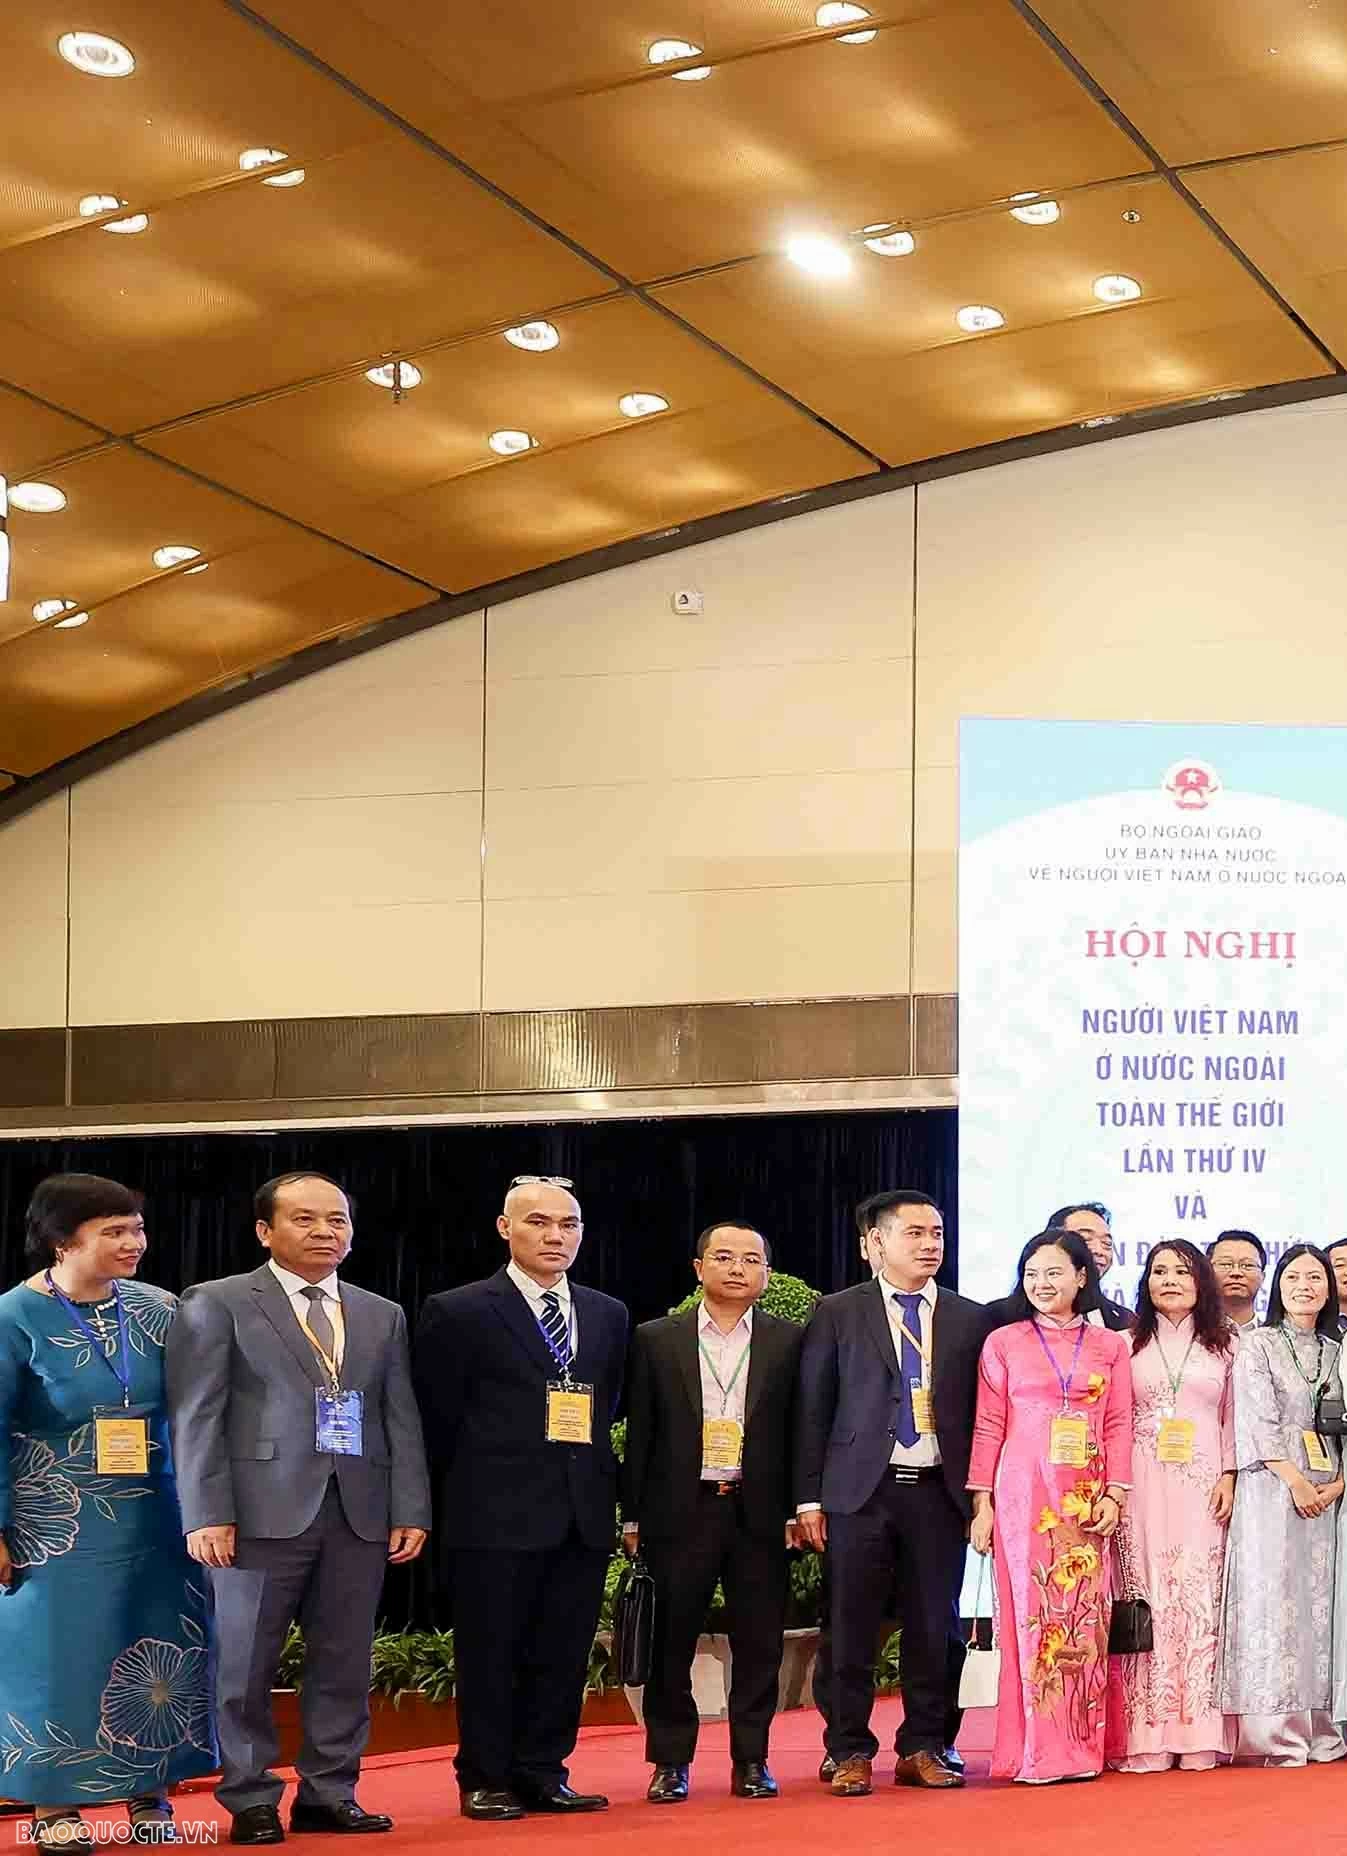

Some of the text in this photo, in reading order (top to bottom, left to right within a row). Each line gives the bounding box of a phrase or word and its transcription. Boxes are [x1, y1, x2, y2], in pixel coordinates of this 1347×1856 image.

[1216, 824, 1262, 841] GIAO
[1135, 847, 1174, 861] BAN
[1171, 869, 1211, 882] NAM
[1084, 921, 1297, 969] HỘI NGHỊ
[1173, 1003, 1229, 1041] VIỆT
[1237, 1009, 1299, 1035] NAM
[1122, 1049, 1194, 1082] NƯỚC
[1175, 1091, 1224, 1128] THẾ
[1183, 1142, 1236, 1174] THỨ
[1242, 1148, 1267, 1174] IV
[1174, 1189, 1208, 1220] VÀ
